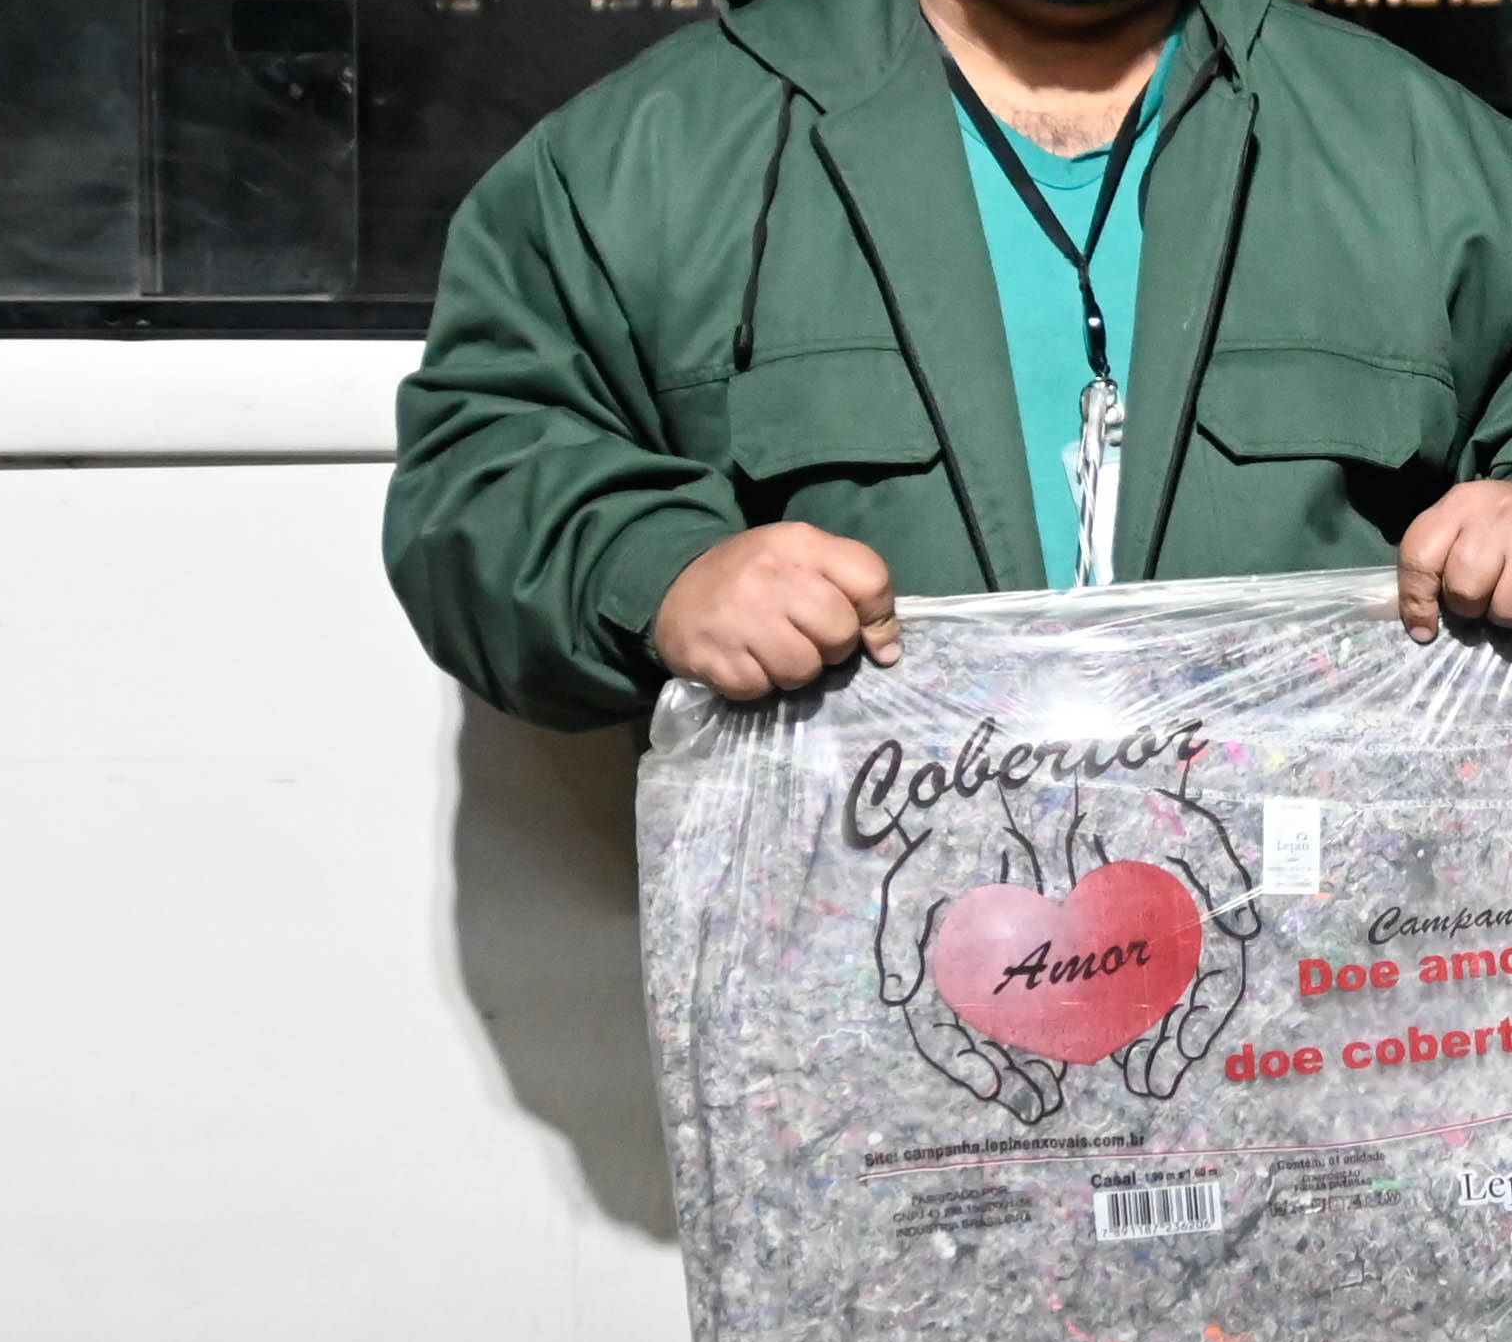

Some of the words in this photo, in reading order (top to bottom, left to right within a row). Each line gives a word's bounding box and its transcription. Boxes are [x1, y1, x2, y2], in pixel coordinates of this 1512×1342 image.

[992, 940, 1152, 995] Amor
[1298, 958, 1400, 997] Doe
[1224, 1043, 1325, 1082] doe
[1090, 1171, 1137, 1188] Casal
